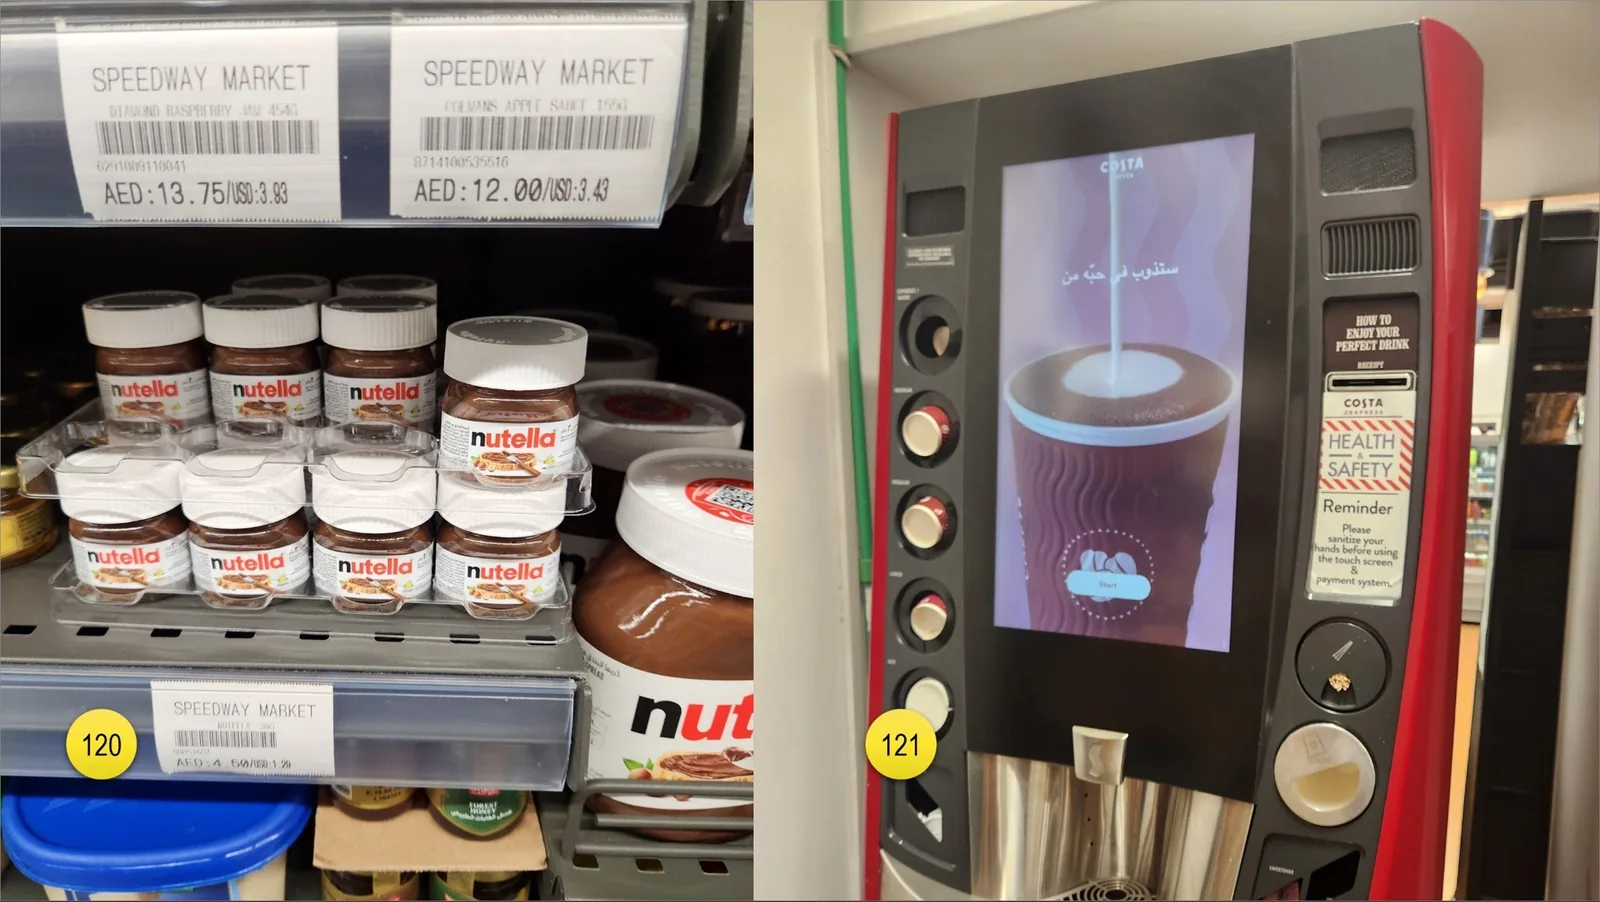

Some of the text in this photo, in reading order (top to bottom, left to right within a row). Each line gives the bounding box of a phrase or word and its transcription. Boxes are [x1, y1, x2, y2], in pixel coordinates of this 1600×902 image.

[92, 65, 311, 92] SPEEDWAY MARKET
[424, 58, 654, 87] SPEEDWAY MARKET
[109, 104, 160, 118] DIAMOND
[505, 100, 542, 113] APPLE
[1100, 156, 1144, 173] COSTA
[1062, 272, 1079, 286] من
[1356, 314, 1392, 327] HOW TO
[1346, 326, 1400, 339] ENJOY YOUR
[1336, 339, 1409, 352] PERFECT DRINK
[110, 380, 178, 398] nutella
[233, 380, 303, 398] nutella
[350, 382, 420, 401] nutella
[1344, 398, 1383, 409] COSTA
[471, 427, 556, 448] nutella
[1329, 434, 1395, 450] HEALTH
[1328, 461, 1393, 478] SAFETY
[1323, 499, 1394, 515] Reminder
[1342, 524, 1371, 535] Please
[1328, 534, 1384, 547] sanitize your
[88, 547, 161, 566] nutella
[1314, 543, 1398, 560] hands before using
[211, 553, 284, 572] nutella
[338, 557, 413, 576] nutella
[1318, 554, 1393, 567] the touch screen
[467, 562, 544, 581] nutella
[1350, 566, 1359, 575] &
[1316, 575, 1356, 586] payment
[173, 701, 316, 719] SPEEDWAY MARKET
